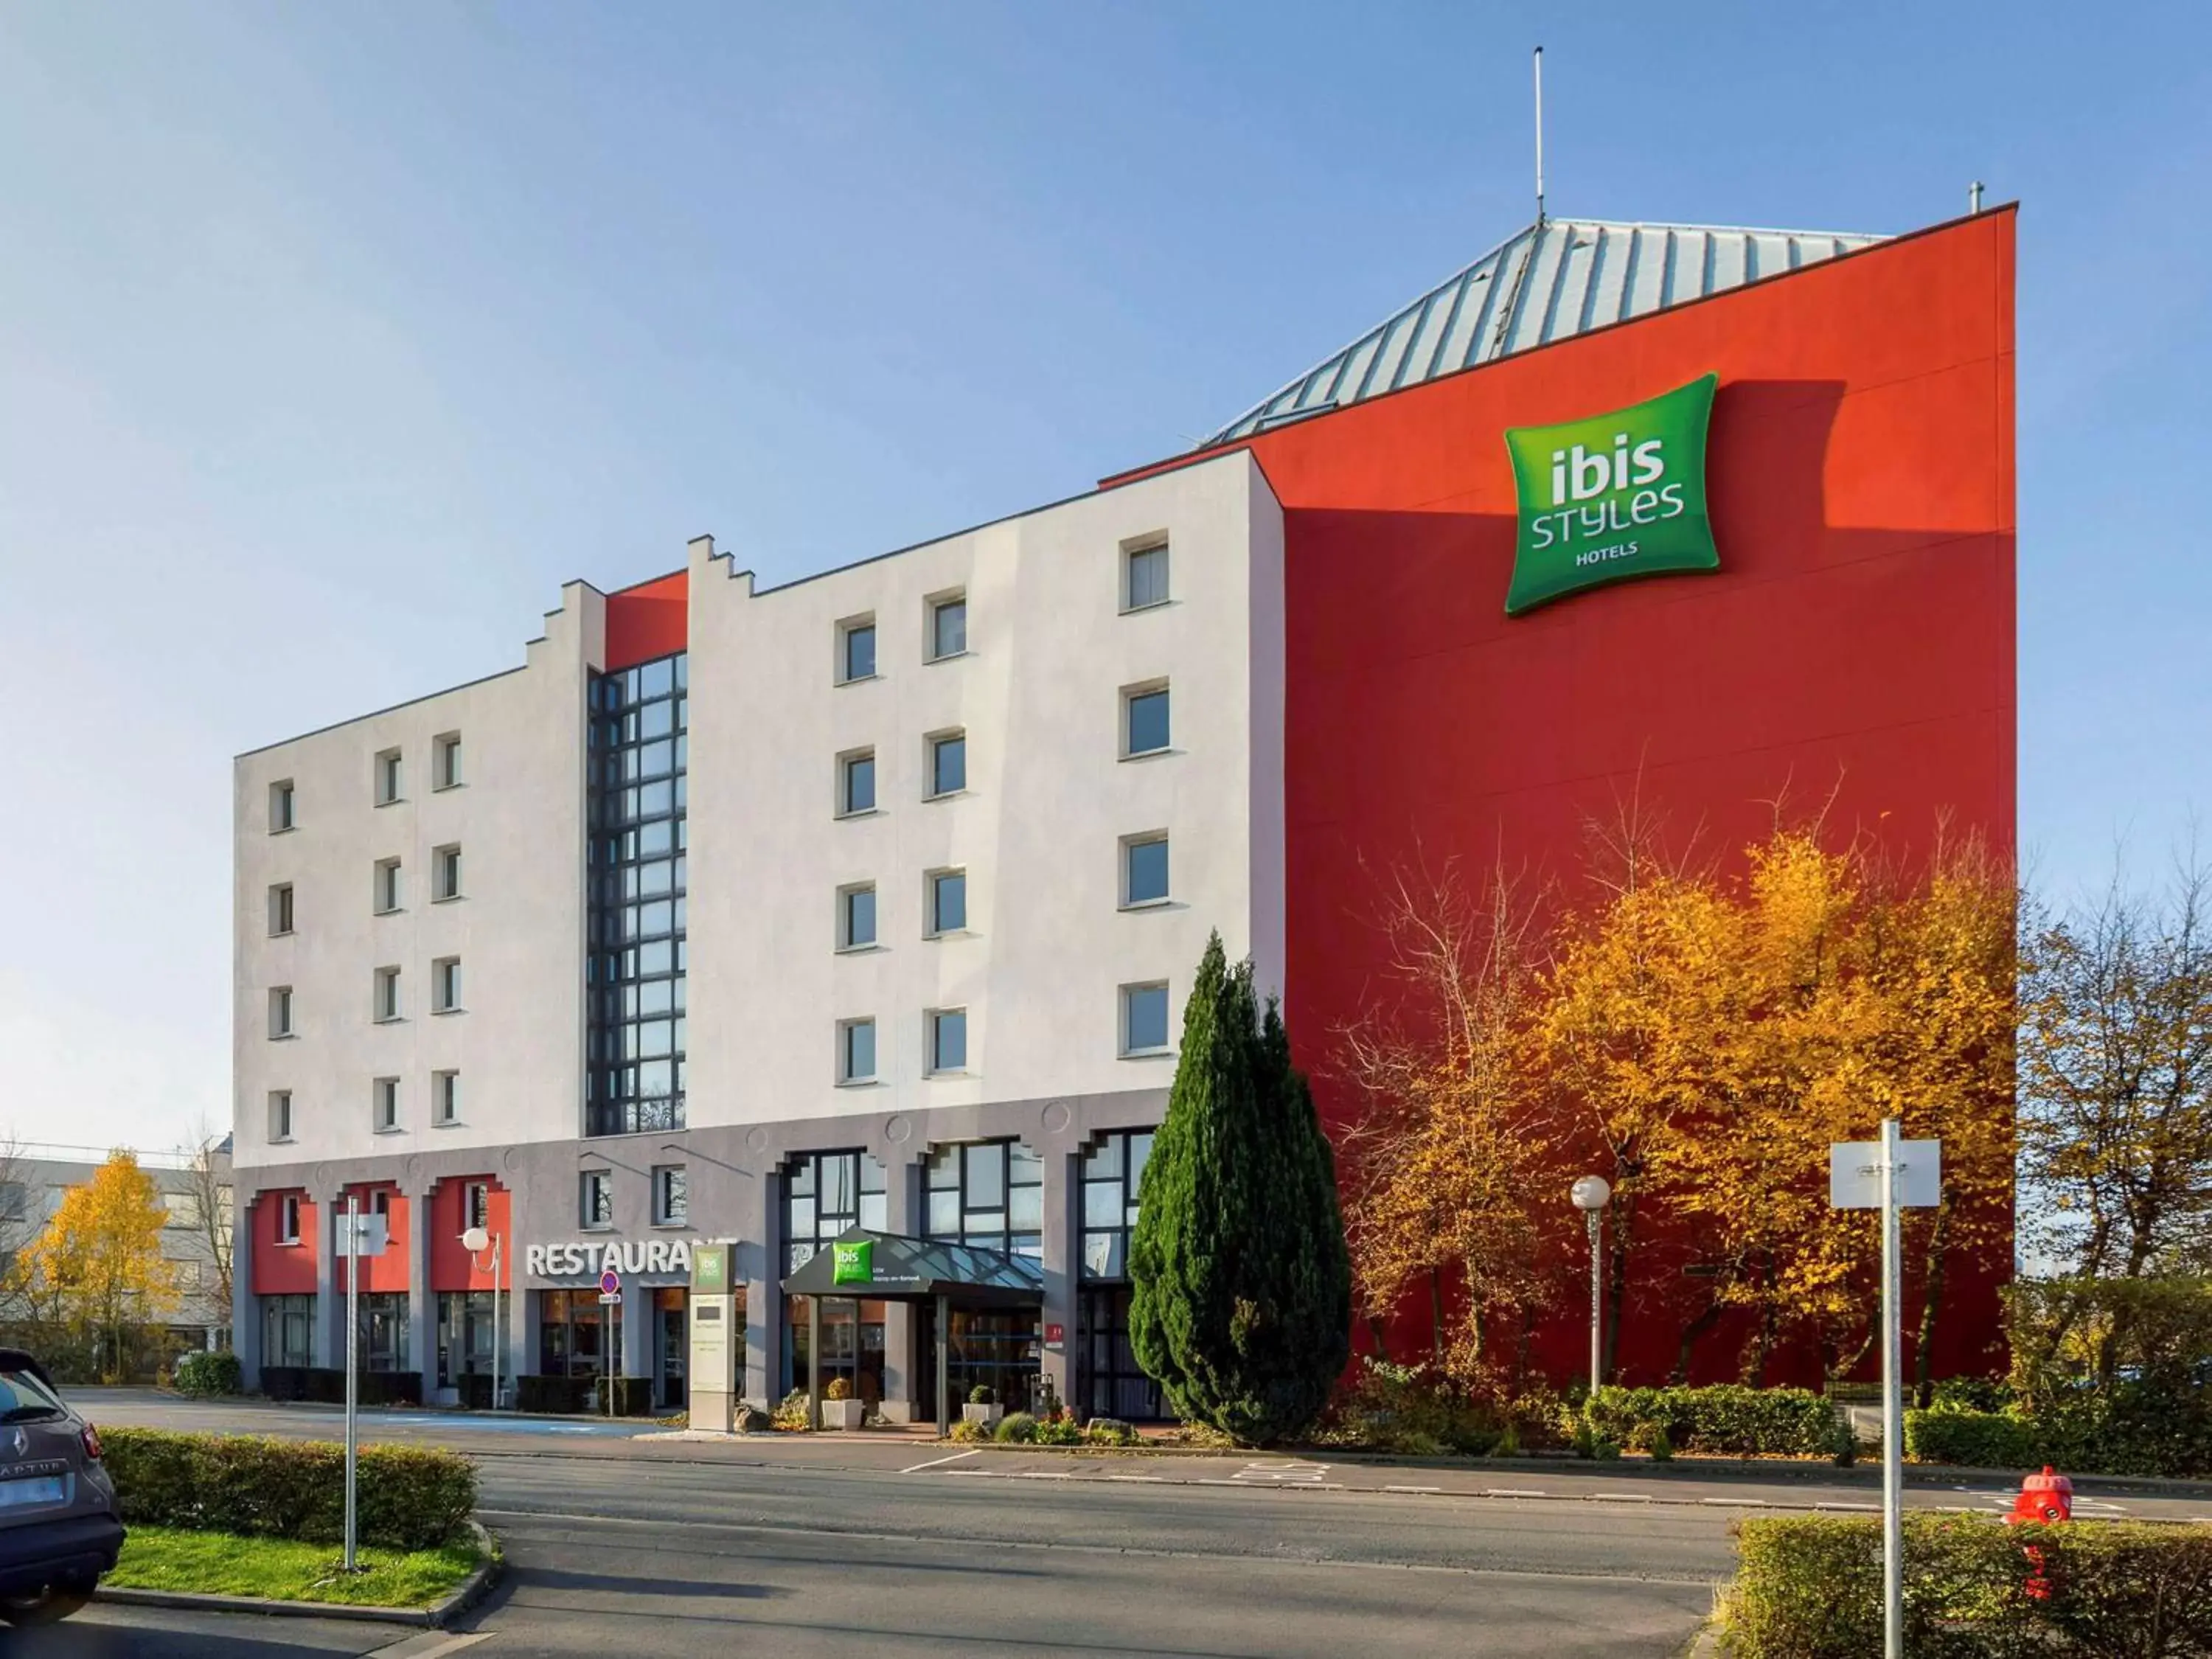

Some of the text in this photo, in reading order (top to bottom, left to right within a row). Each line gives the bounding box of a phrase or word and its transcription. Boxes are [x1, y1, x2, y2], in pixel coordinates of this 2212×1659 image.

[1552, 432, 1664, 506] ibis
[1576, 540, 1638, 567] HOTELS
[526, 1237, 737, 1276] RESTAURA
